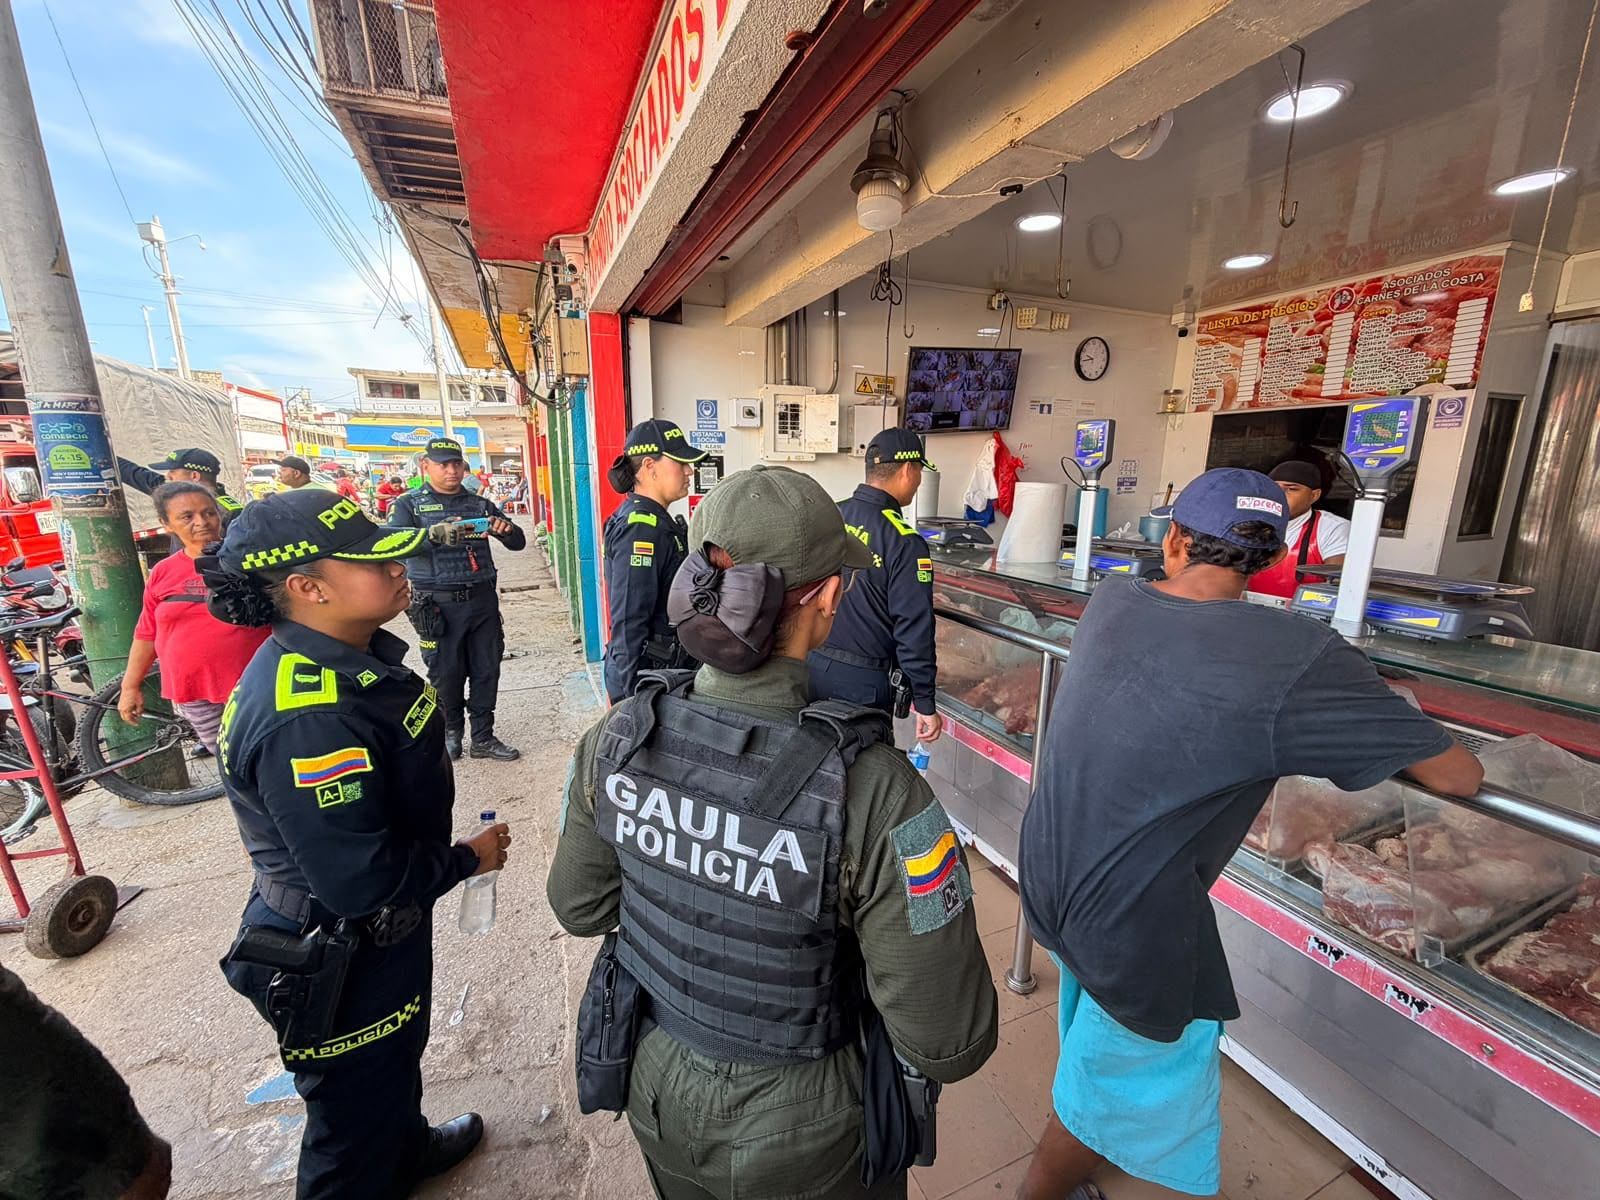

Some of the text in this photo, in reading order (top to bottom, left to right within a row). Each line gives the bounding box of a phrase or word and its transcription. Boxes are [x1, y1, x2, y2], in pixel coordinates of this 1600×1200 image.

[1356, 273, 1484, 305] CARNES DE LA COSTA
[1382, 268, 1451, 289] ASOCIADOS
[1208, 300, 1318, 330] LISTA DE PRECIOS
[1362, 307, 1392, 317] Cerdo
[1392, 326, 1432, 336] ahumada
[39, 422, 86, 434] EXPO
[322, 789, 339, 802] A-
[605, 773, 809, 874] GAULA
[615, 812, 782, 903] POLICIA
[319, 1022, 394, 1056] POLICÍA
